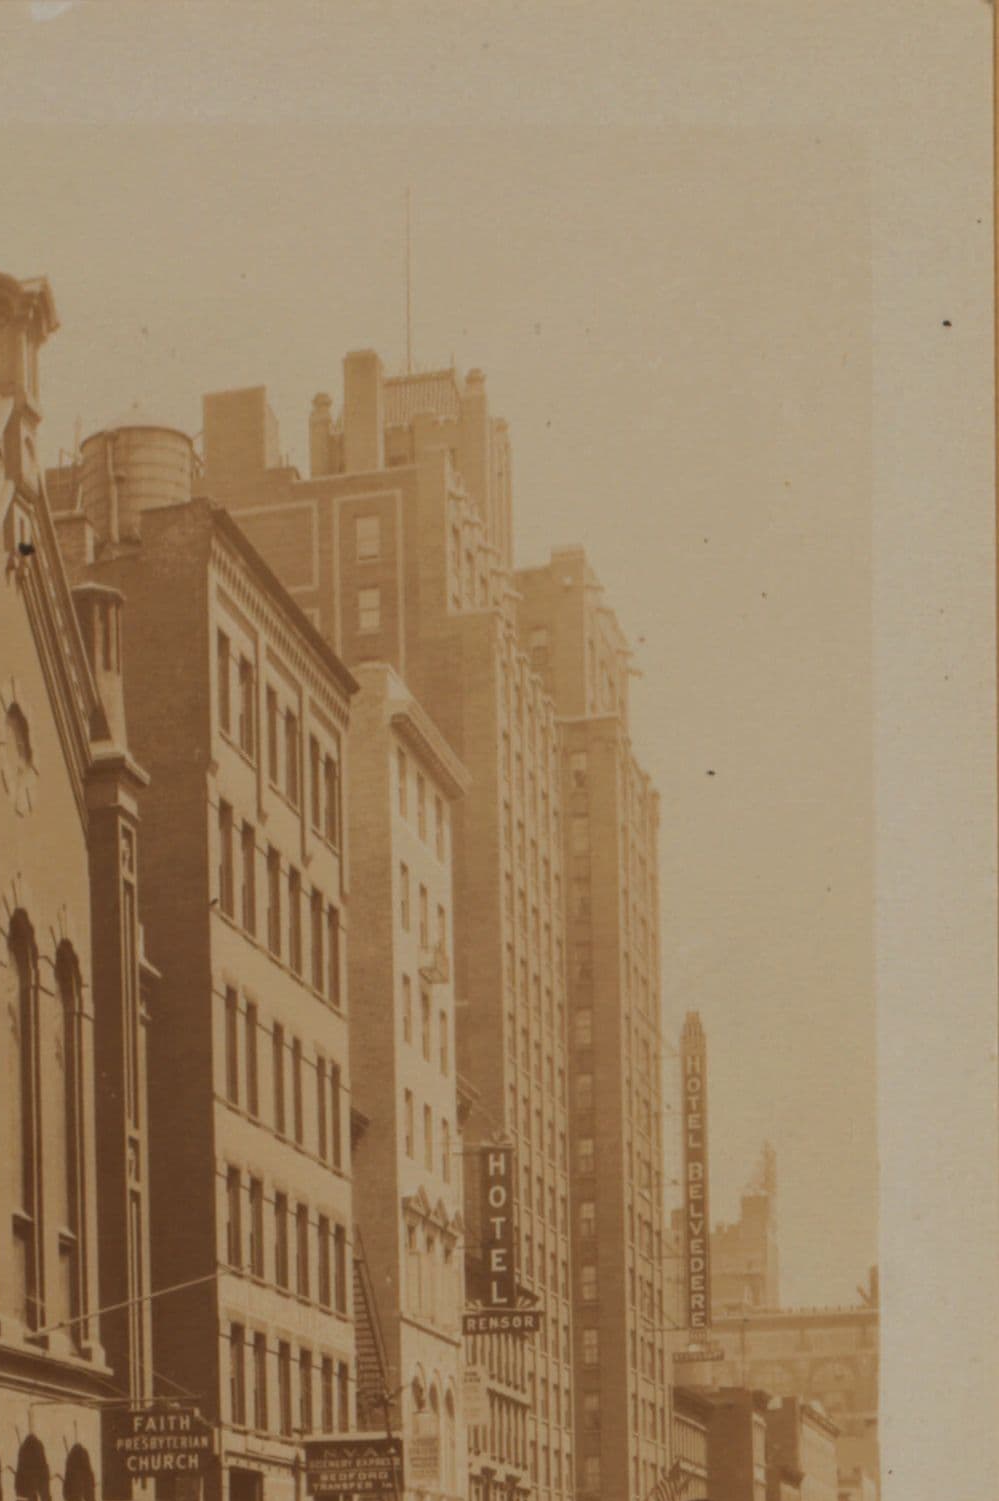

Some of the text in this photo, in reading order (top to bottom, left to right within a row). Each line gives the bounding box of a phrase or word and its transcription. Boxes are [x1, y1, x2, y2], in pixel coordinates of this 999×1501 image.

[687, 1054, 706, 1329] HOTEL BELVEDERE
[487, 1152, 508, 1305] HOTEL
[133, 1414, 190, 1432] FAITH
[116, 1435, 208, 1451] PRESBYTERIAN
[126, 1452, 199, 1471] CHURCH
[312, 1481, 373, 1491] TRANSFER
